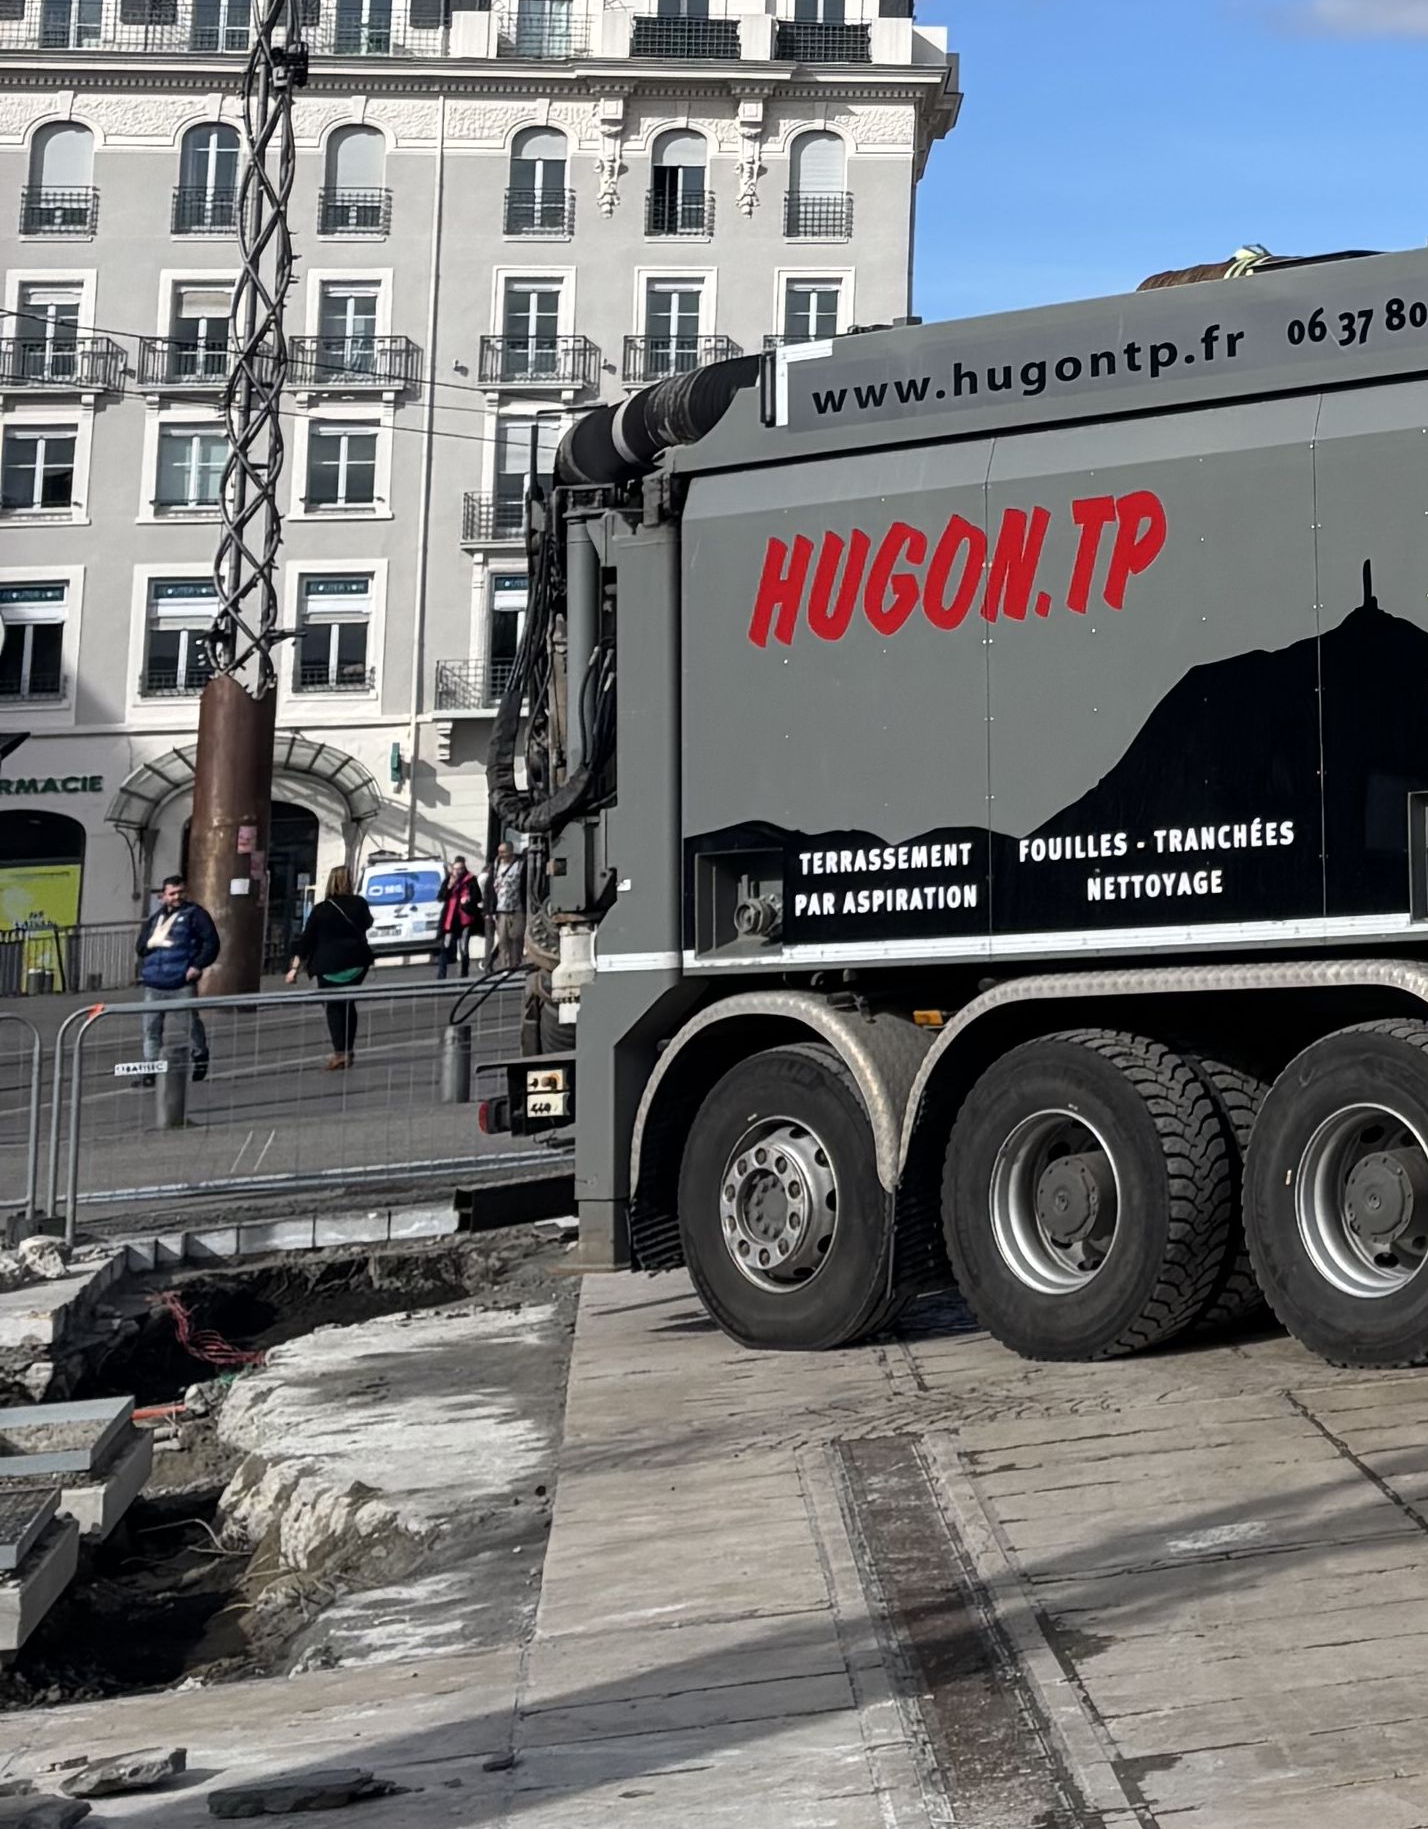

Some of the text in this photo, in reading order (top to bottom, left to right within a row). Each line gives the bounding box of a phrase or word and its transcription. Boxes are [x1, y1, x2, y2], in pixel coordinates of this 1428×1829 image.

[1287, 307, 1327, 345] 06
[1338, 309, 1374, 346] 37
[1385, 298, 1428, 331] 80
[812, 324, 1245, 415] www.hugontp.fr
[748, 490, 1168, 648] HUGON.TP
[799, 842, 972, 876] TERRASSEMENT
[1019, 832, 1128, 862] FOUILLES
[1154, 817, 1295, 853] TRANCHÉES
[795, 884, 977, 917] PAR ASPIRATION
[1087, 869, 1223, 901] NETTOYAGE
